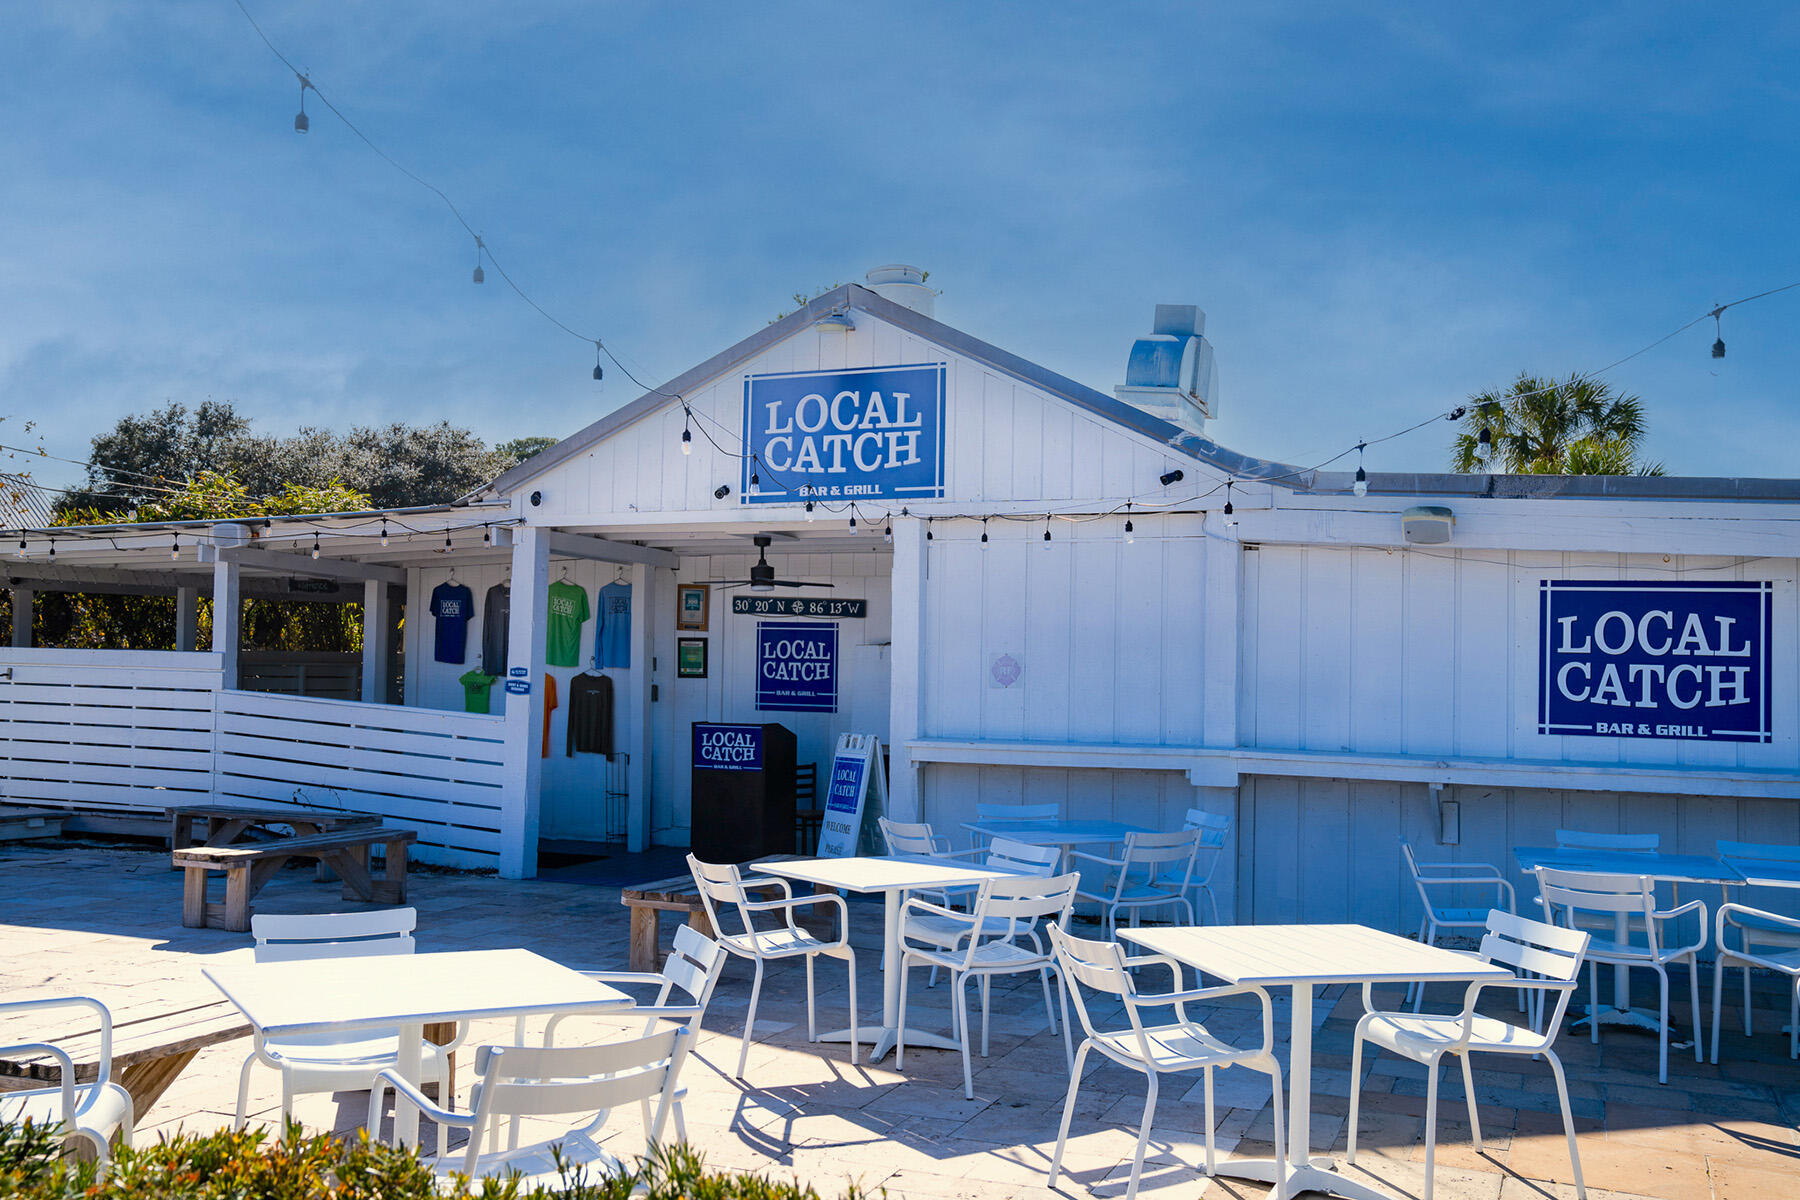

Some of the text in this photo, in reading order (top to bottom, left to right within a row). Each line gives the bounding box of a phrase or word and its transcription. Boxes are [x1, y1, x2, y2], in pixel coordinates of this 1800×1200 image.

[764, 391, 922, 434] LOCAL
[764, 431, 921, 473] CATCH
[800, 484, 883, 496] BAR & GRILL
[1557, 610, 1751, 657] LOCAL
[763, 640, 830, 660] LOCAL
[763, 661, 830, 681] CATCH
[1557, 662, 1751, 710] CATCH
[1596, 722, 1708, 737] BAR & GRILL
[702, 732, 756, 747] LOCAL
[702, 746, 755, 762] CATCH
[837, 769, 857, 783] LOCAL
[834, 784, 855, 797] CATCH
[826, 821, 852, 835] WELCOME
